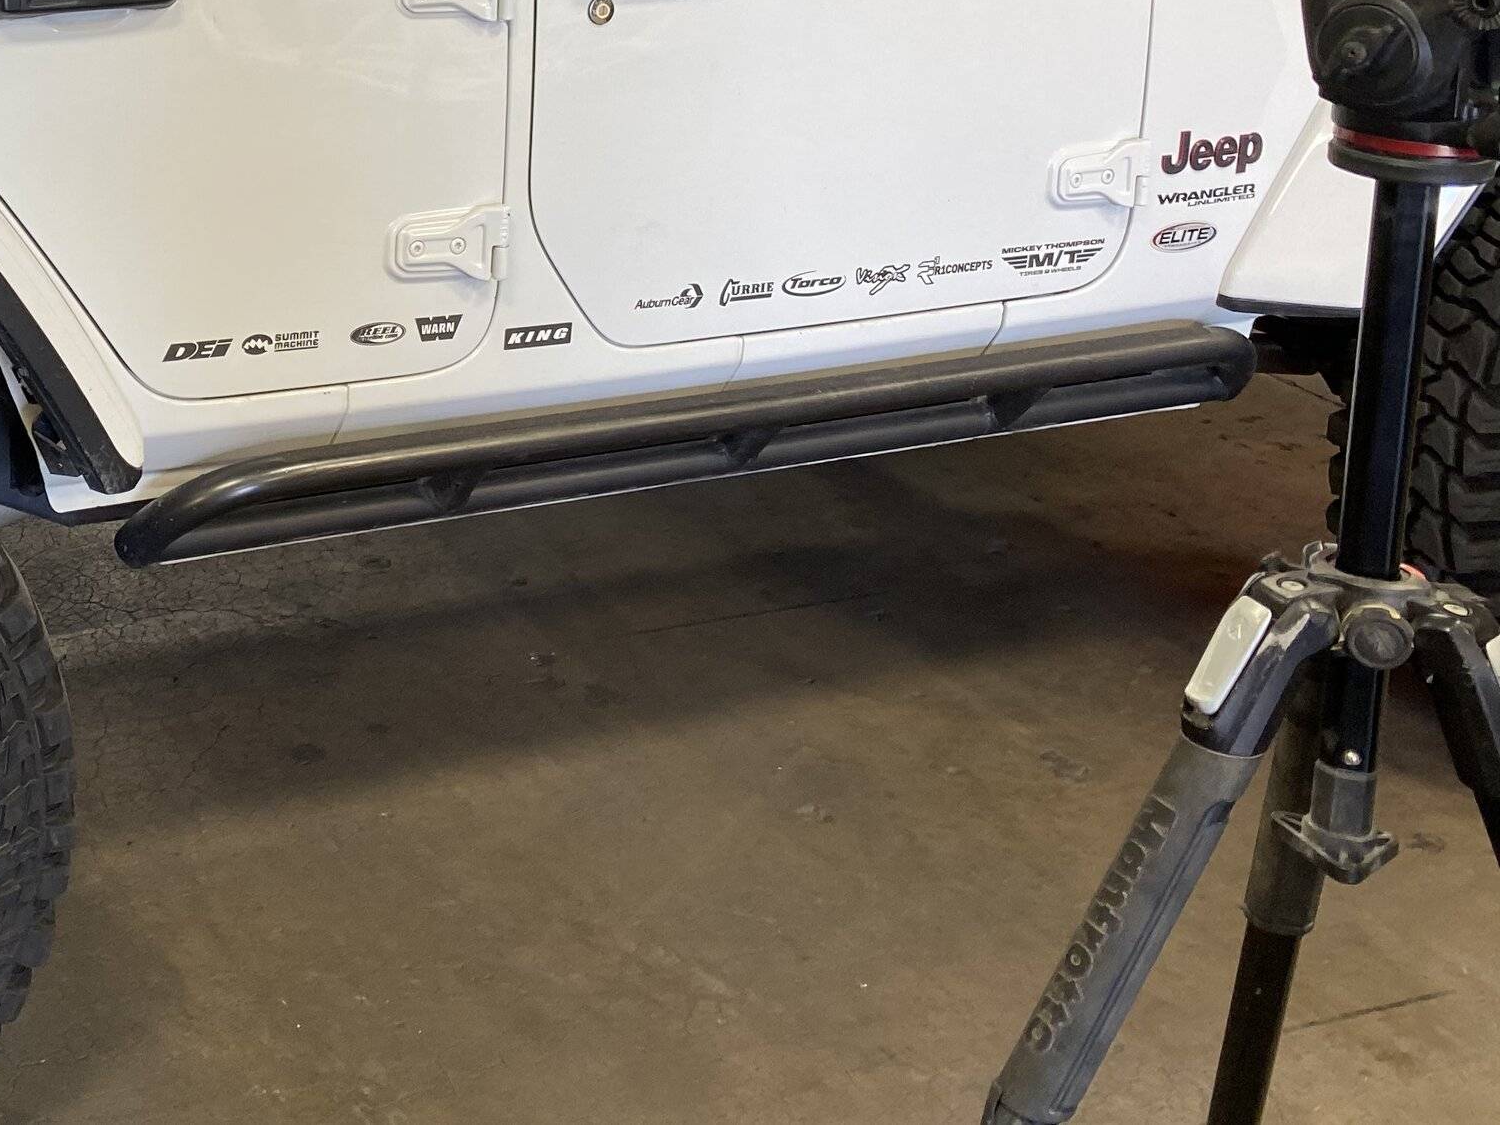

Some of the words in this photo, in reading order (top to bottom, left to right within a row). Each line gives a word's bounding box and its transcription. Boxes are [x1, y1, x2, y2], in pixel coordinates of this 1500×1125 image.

[1161, 130, 1263, 175] Jeep
[1157, 183, 1256, 205] WRANGLER
[1187, 193, 1256, 207] UNLIMITED
[1159, 227, 1211, 245] ELITE
[1002, 244, 1043, 255] MICKEY
[1044, 238, 1106, 250] THOMPSON
[790, 276, 842, 289] Torco
[719, 278, 774, 306] CURRIE
[275, 330, 320, 342] SUMMIT
[421, 321, 455, 335] WARN
[507, 327, 569, 345] KING
[274, 339, 319, 350] MACHINE
[1025, 793, 1178, 1052] Manfrotto
